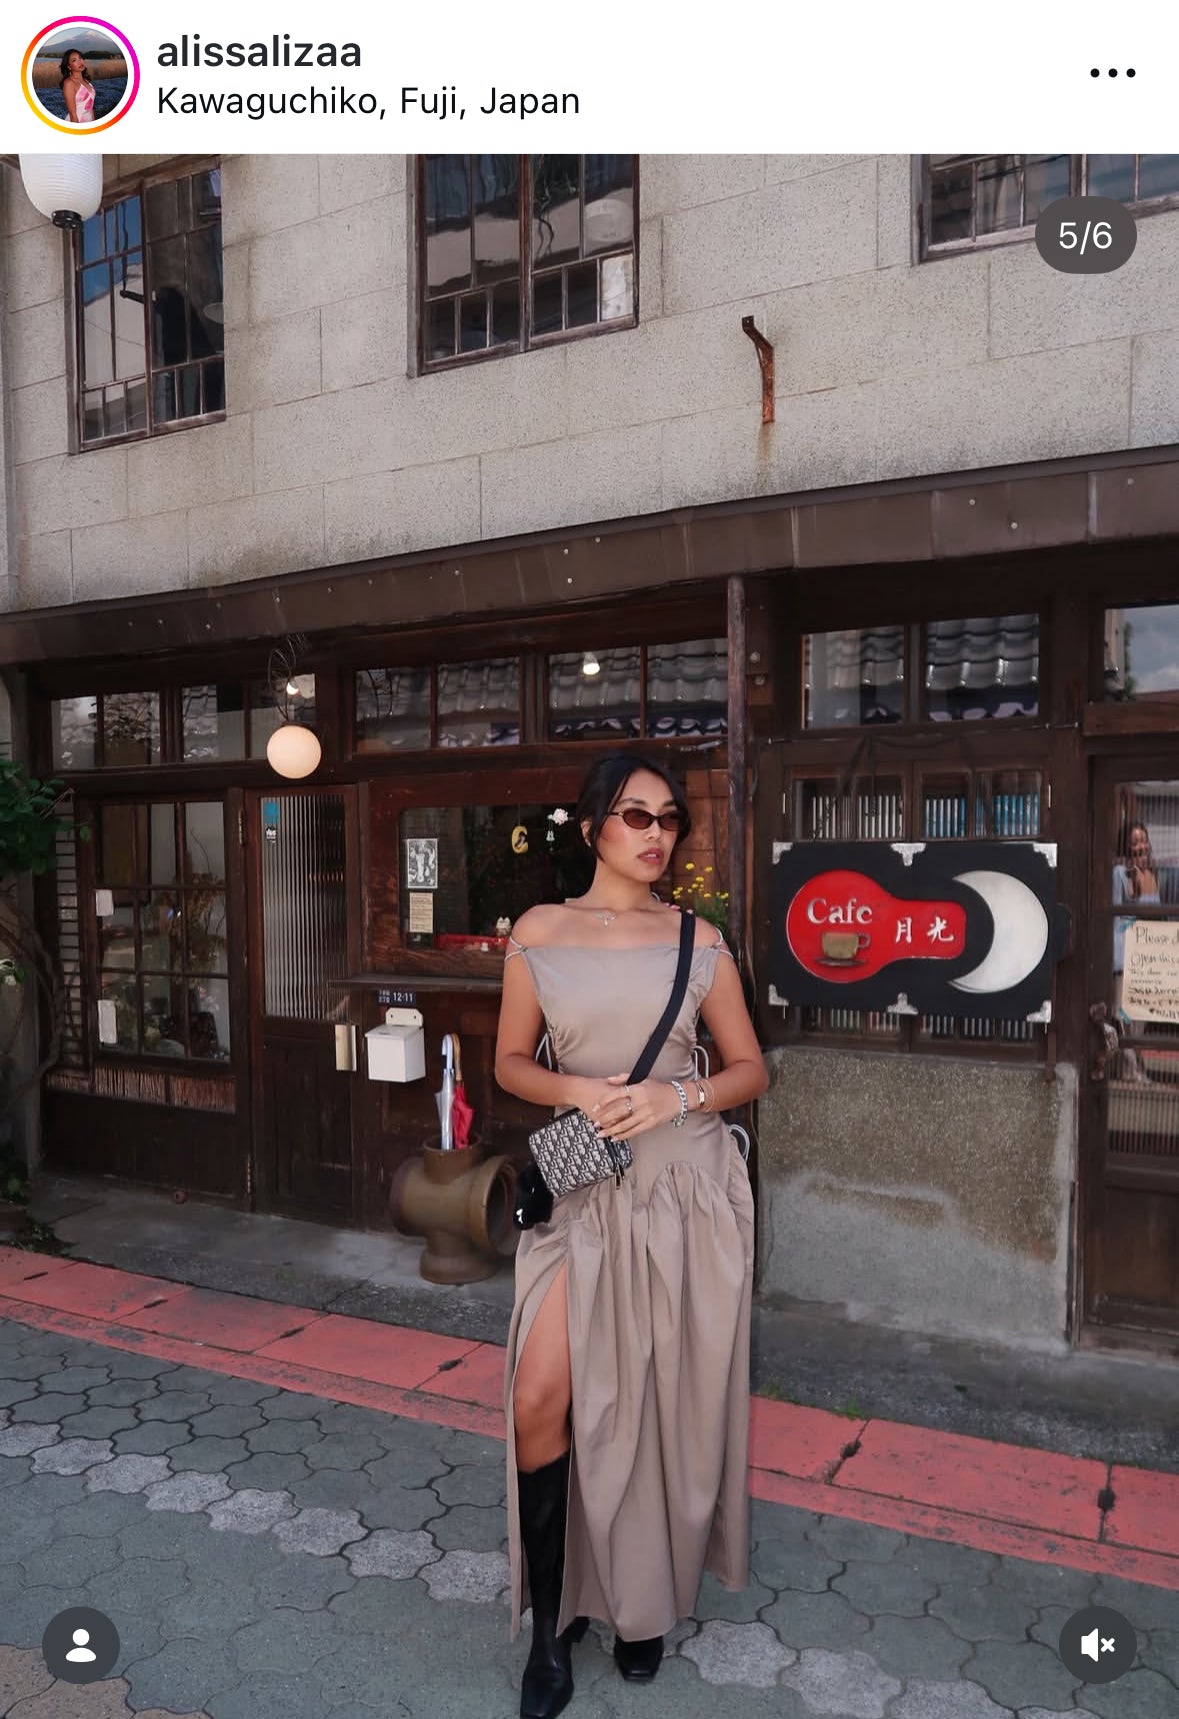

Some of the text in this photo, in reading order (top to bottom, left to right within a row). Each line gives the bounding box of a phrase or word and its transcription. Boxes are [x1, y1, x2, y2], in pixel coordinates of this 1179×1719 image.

[807, 898, 873, 924] Cafe
[895, 917, 954, 944] 月光
[1135, 926, 1169, 944] Please
